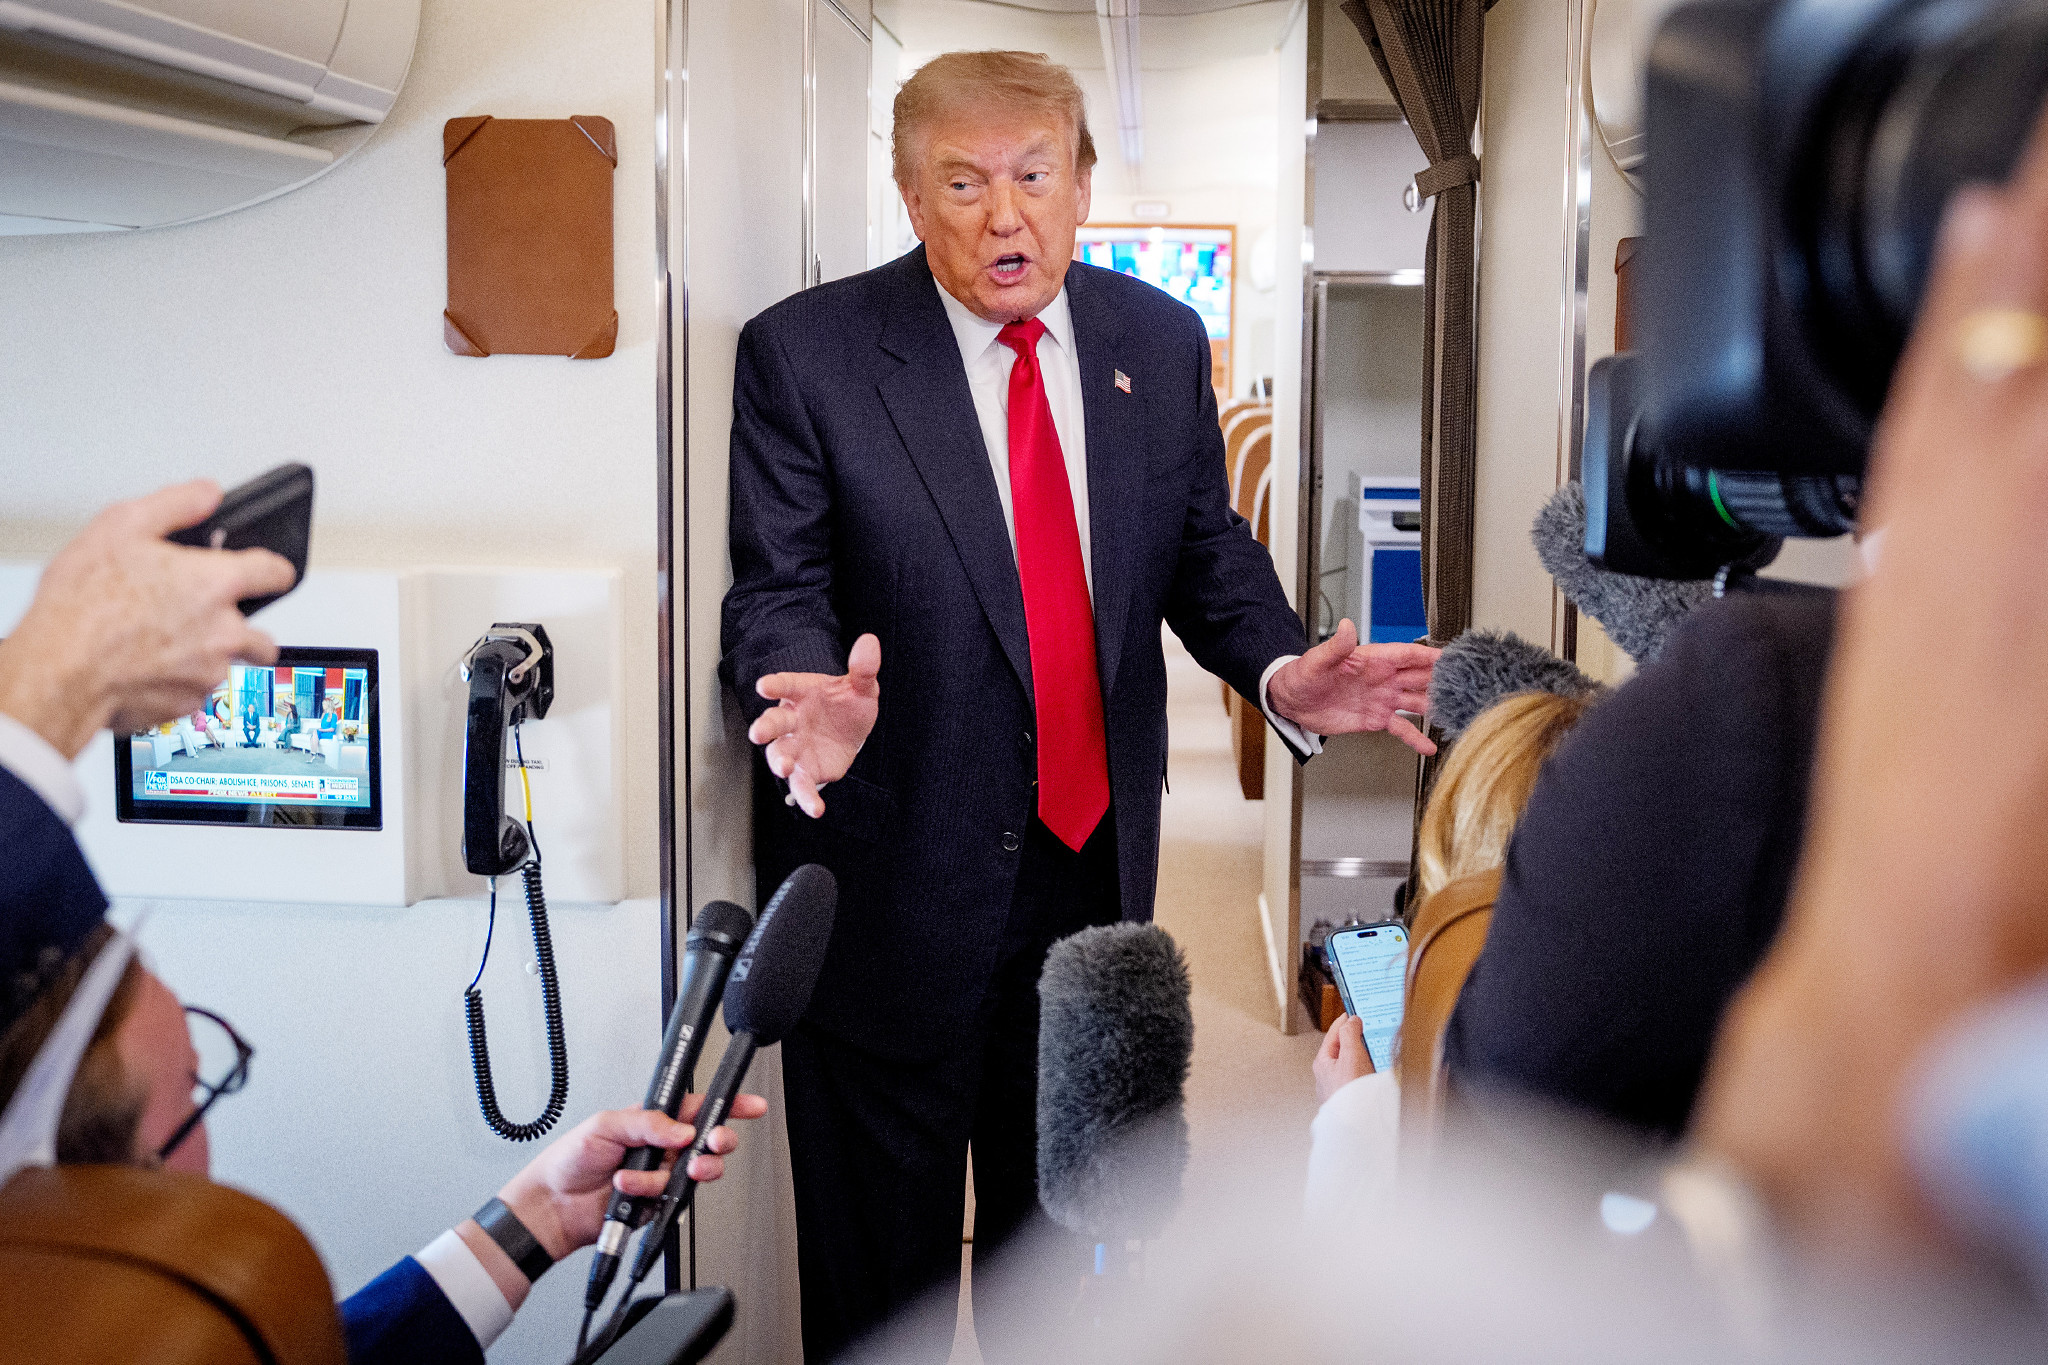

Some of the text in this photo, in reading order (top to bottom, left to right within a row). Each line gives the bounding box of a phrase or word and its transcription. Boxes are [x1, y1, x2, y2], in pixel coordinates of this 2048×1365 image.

[170, 776, 314, 789] DSA CO-CHAIR: ABOLISH ICE, PRISONS, SENATE
